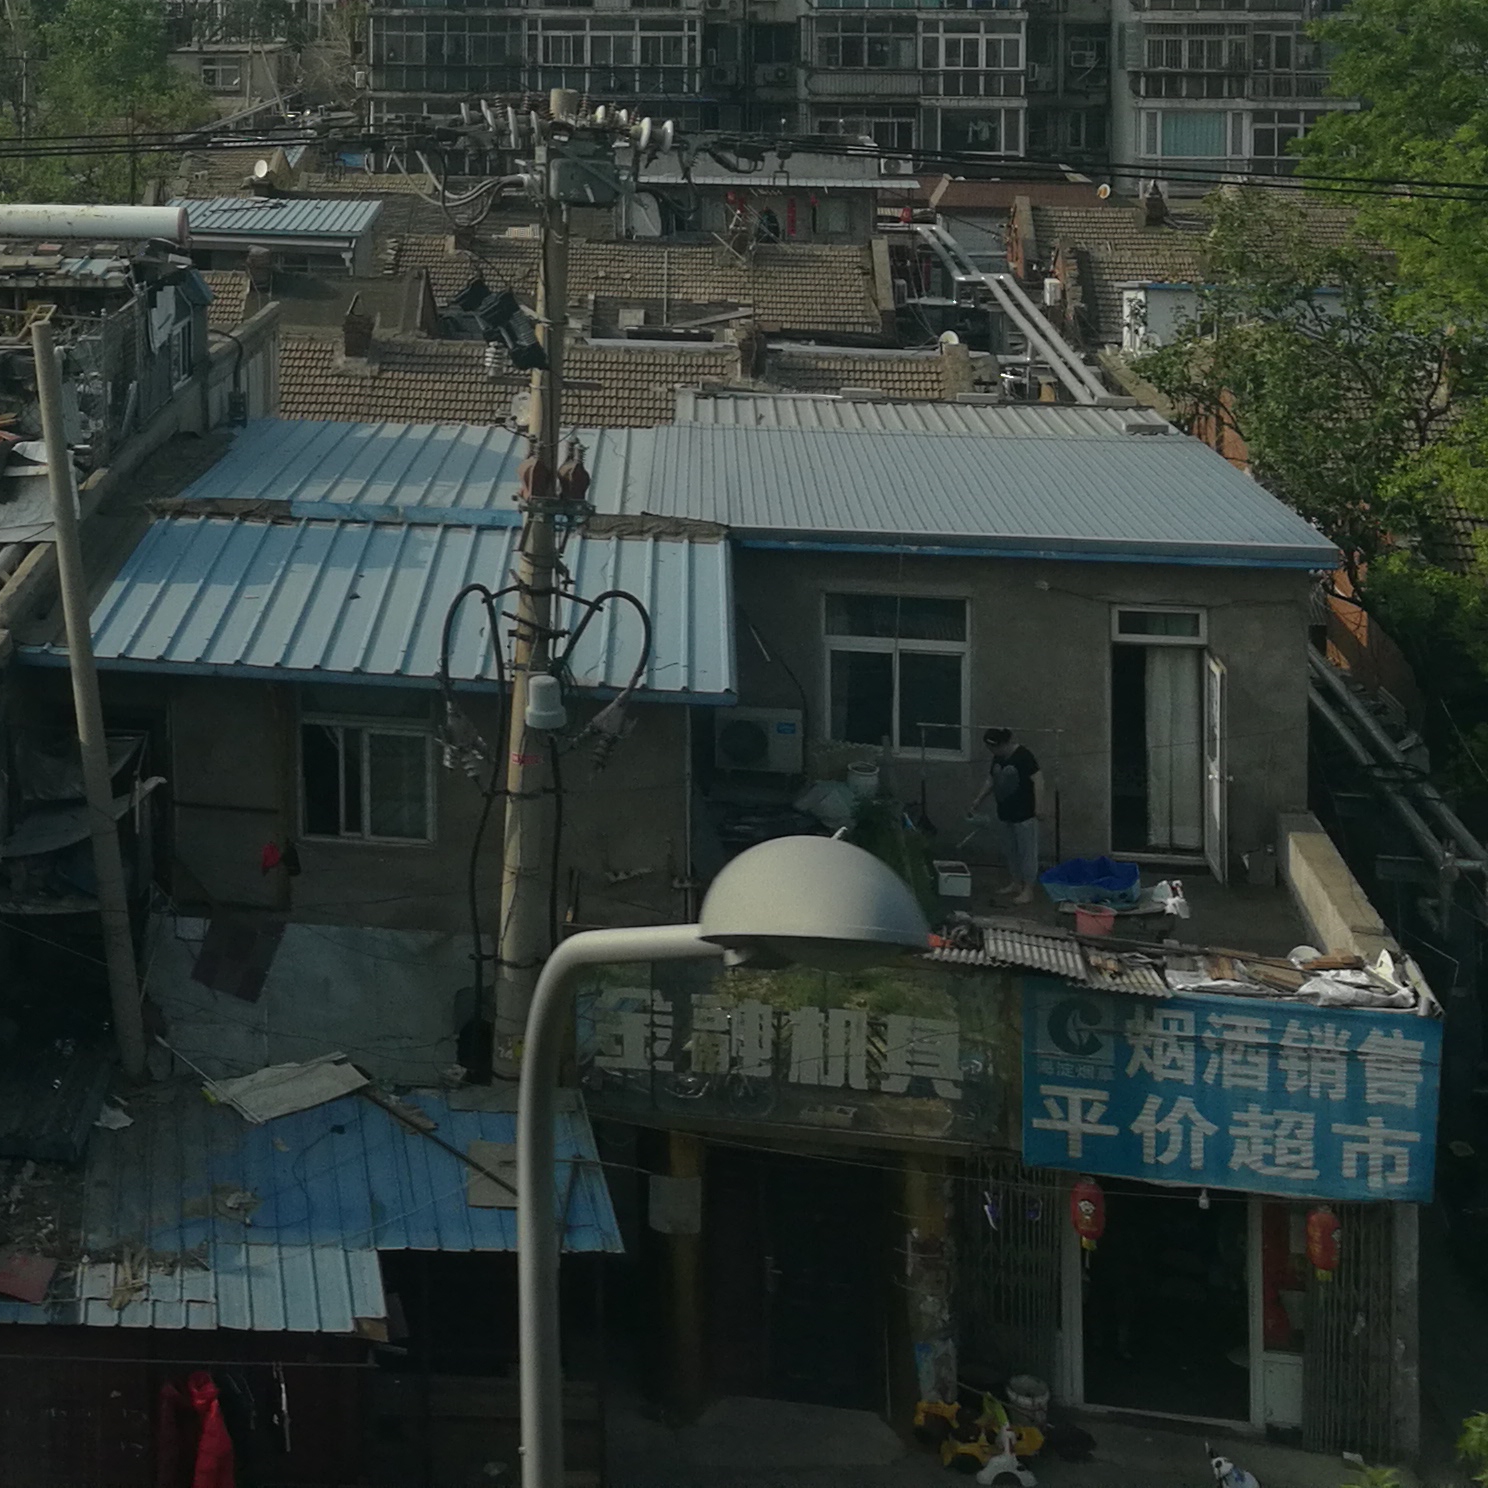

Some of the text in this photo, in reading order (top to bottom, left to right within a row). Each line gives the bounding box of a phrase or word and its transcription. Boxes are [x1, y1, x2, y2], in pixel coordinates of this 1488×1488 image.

[1125, 1005, 1425, 1109] 烟酒销售
[1032, 1085, 1422, 1189] 平价超市
